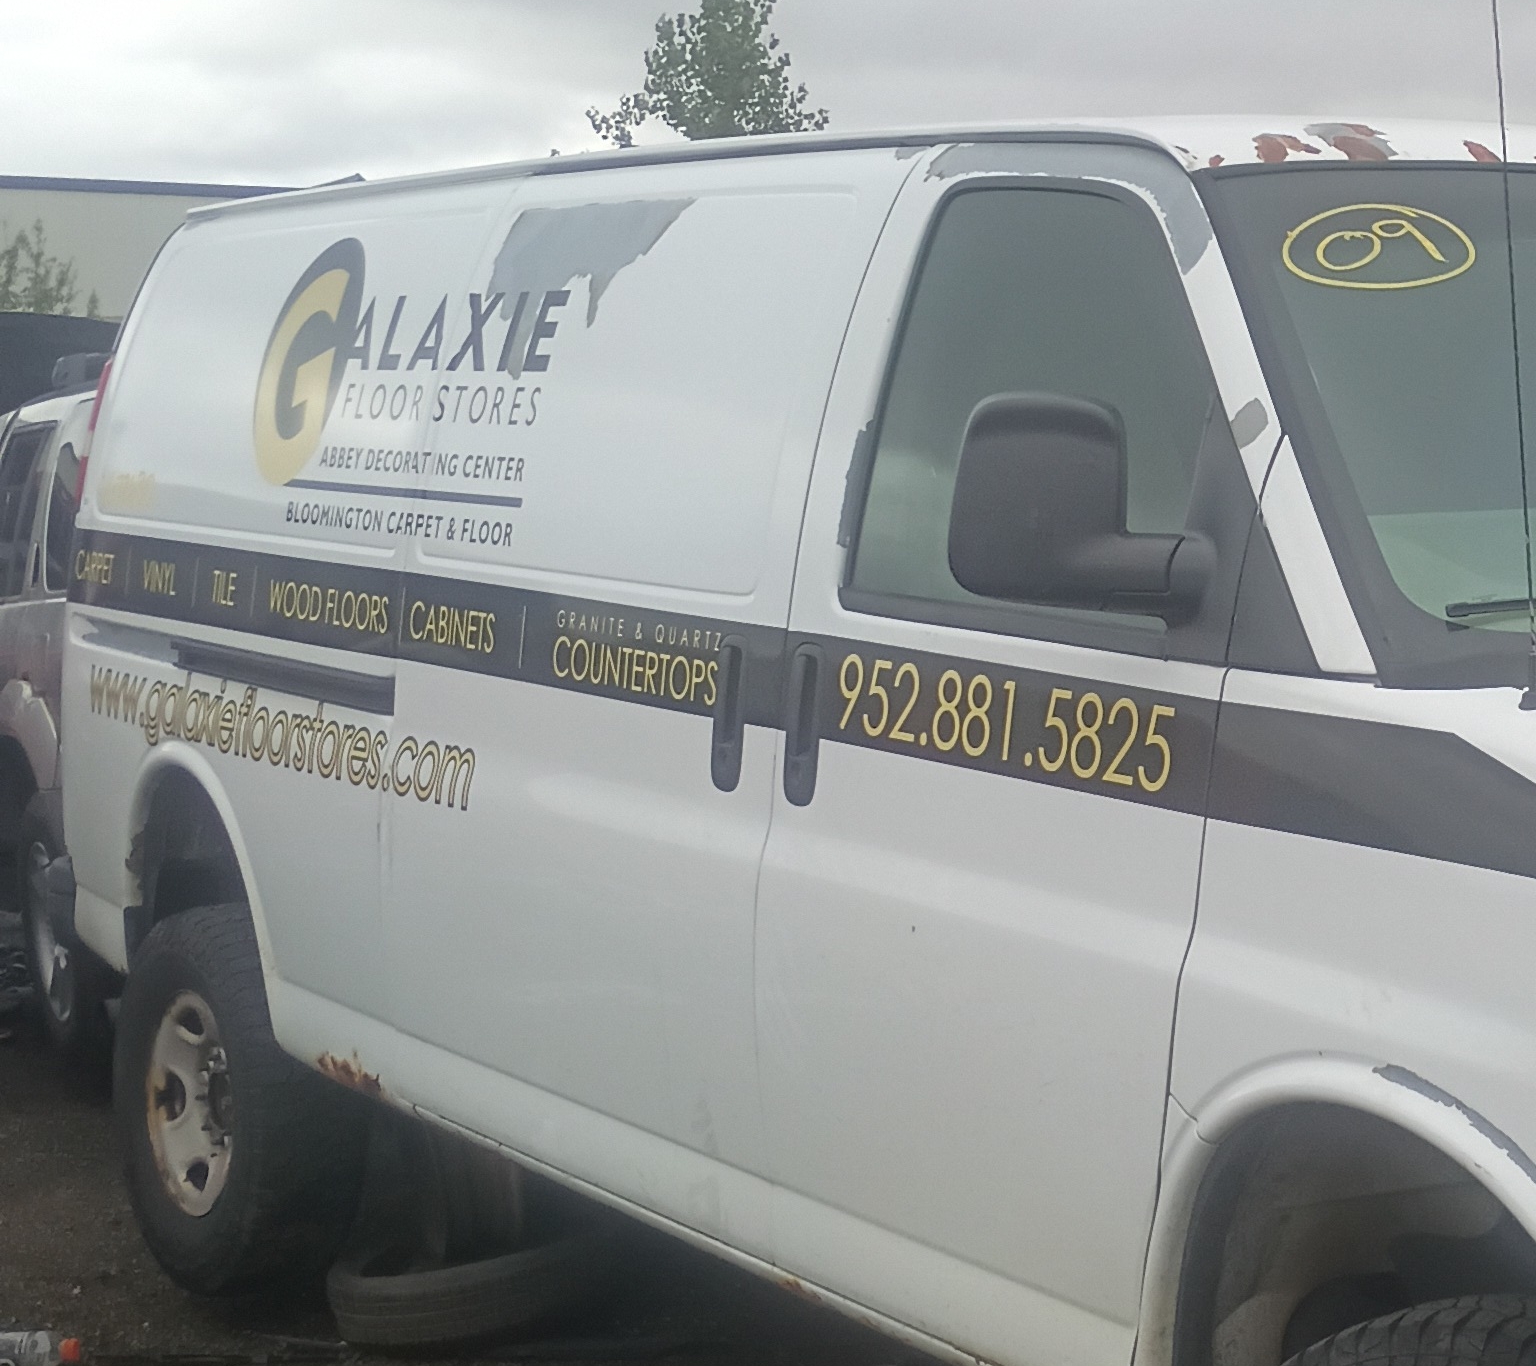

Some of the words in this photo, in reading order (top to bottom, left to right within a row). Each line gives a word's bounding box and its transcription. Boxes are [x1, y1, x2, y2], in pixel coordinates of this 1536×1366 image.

[253, 237, 571, 485] GALAXIE
[341, 383, 423, 421] FLOOR
[432, 385, 541, 426] STORES
[319, 446, 363, 469] ABBEY
[365, 449, 458, 477] DECORATING
[462, 454, 525, 482] CENTER
[286, 501, 384, 532] BLOOMINGTON
[386, 511, 443, 539] CARPET
[446, 518, 457, 540] &
[461, 518, 513, 546] FLOOR
[75, 549, 114, 584] CARPET
[143, 559, 176, 596] VINYL
[211, 569, 238, 606] TILE
[270, 579, 322, 622] WOOD
[324, 588, 389, 633] FLOORS
[409, 600, 496, 654] CABINETS
[556, 609, 625, 637] GRANITE
[634, 622, 643, 640] &
[654, 623, 722, 651] QUARTZ
[553, 635, 719, 706] COUNTERTOPS
[90, 664, 476, 811] www.galaxiefloorstores.com
[839, 653, 1176, 793] 952.881.5825
